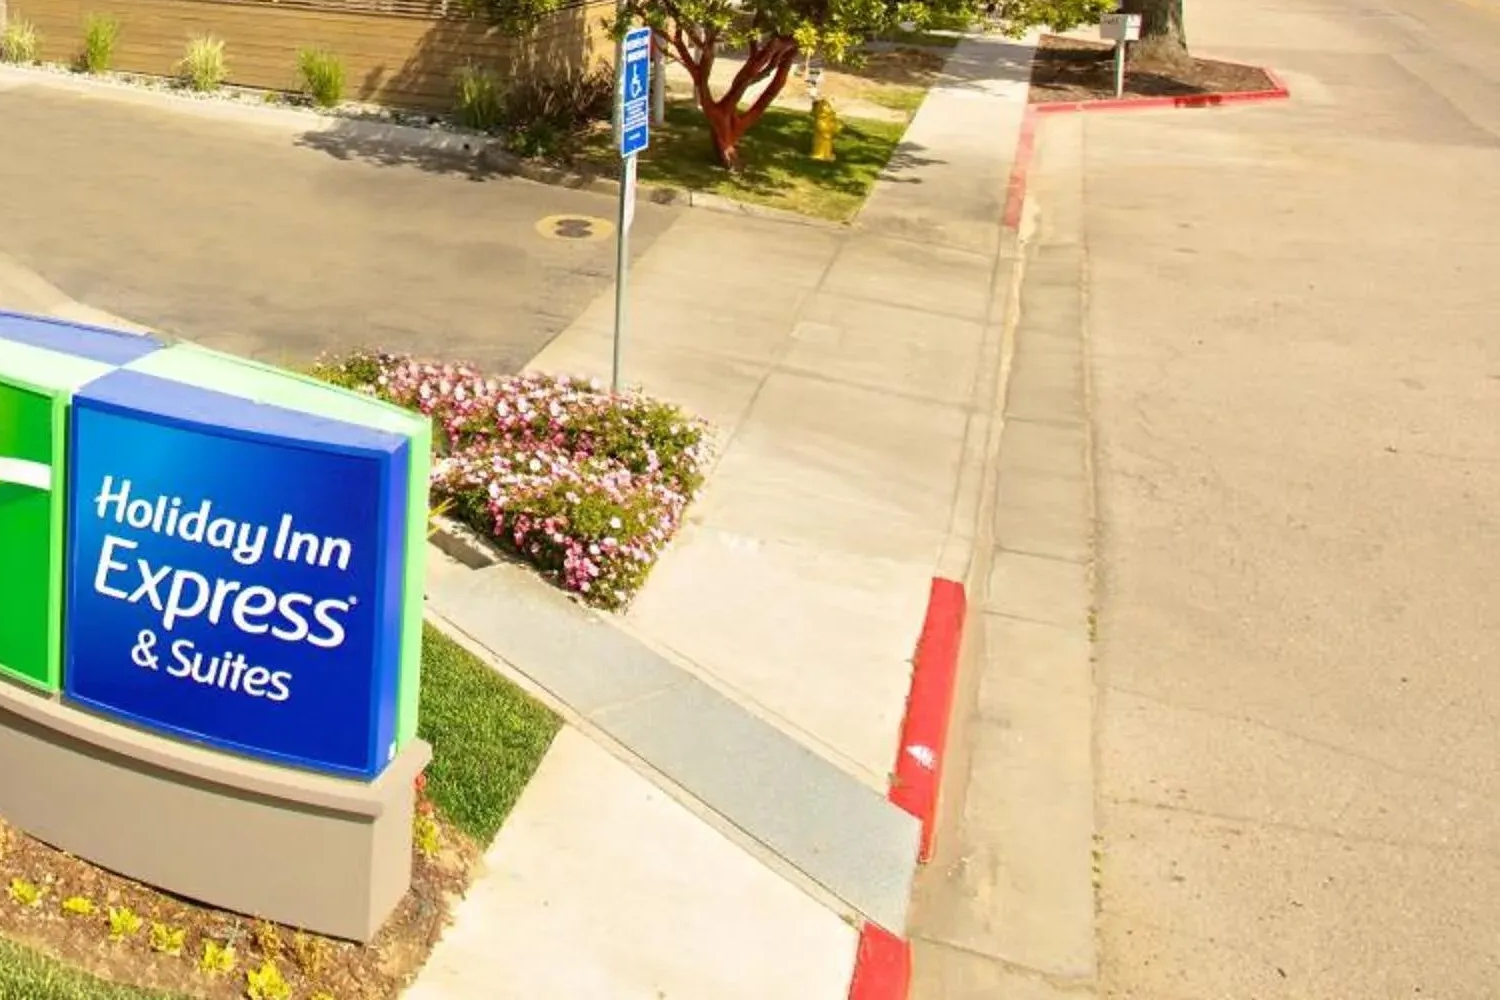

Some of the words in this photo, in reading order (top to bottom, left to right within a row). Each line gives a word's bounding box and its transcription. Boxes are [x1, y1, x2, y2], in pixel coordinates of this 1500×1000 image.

[94, 474, 269, 566] Holiday
[272, 512, 353, 571] Inn
[93, 533, 350, 649] Express
[130, 628, 159, 671] &
[166, 638, 293, 702] Suites
